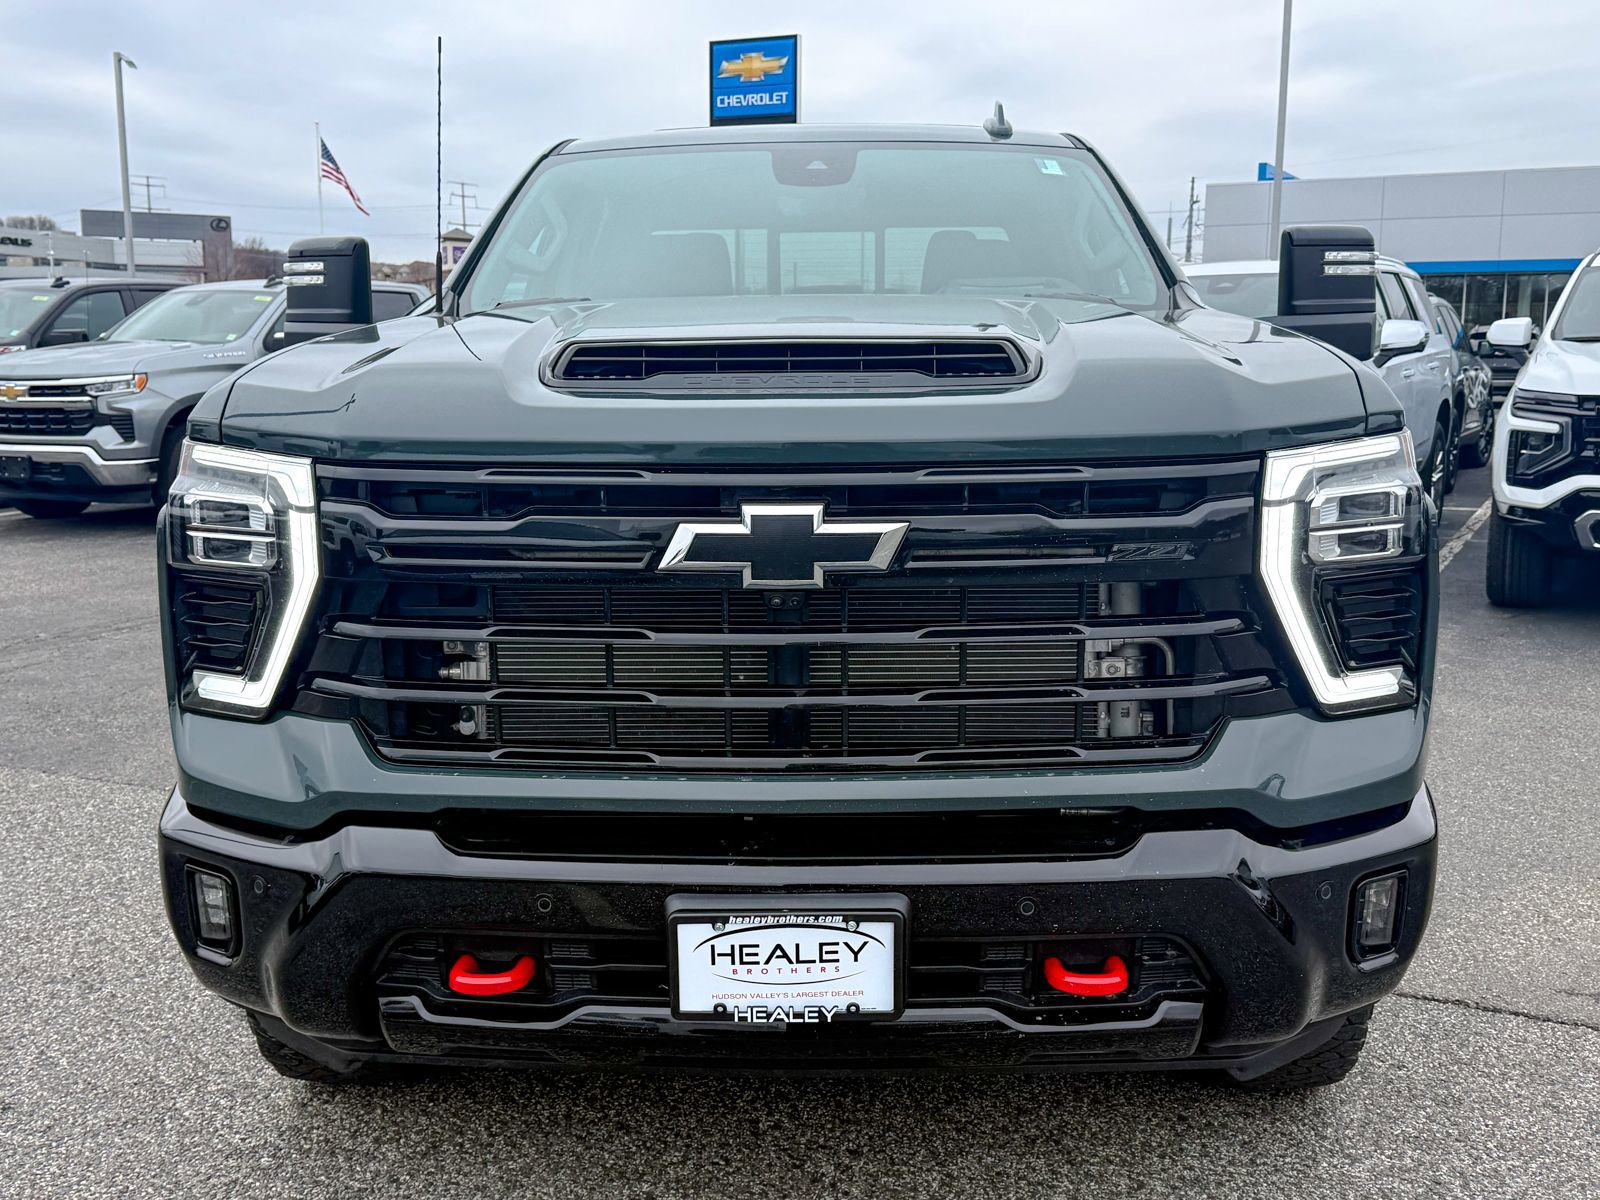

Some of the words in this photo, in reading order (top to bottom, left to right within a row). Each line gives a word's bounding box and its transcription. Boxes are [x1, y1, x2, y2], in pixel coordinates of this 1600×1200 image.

[717, 91, 789, 108] CHEVROLET
[0, 236, 32, 247] EXUS
[728, 914, 844, 925] healeybrothers.com
[710, 941, 870, 966] HEALEY
[732, 965, 841, 975] BROTHERS
[711, 992, 748, 1000] HUDSON
[749, 991, 789, 1000] VALLEY'S
[790, 991, 829, 999] LARGEST
[734, 1006, 839, 1023] HEALEY
